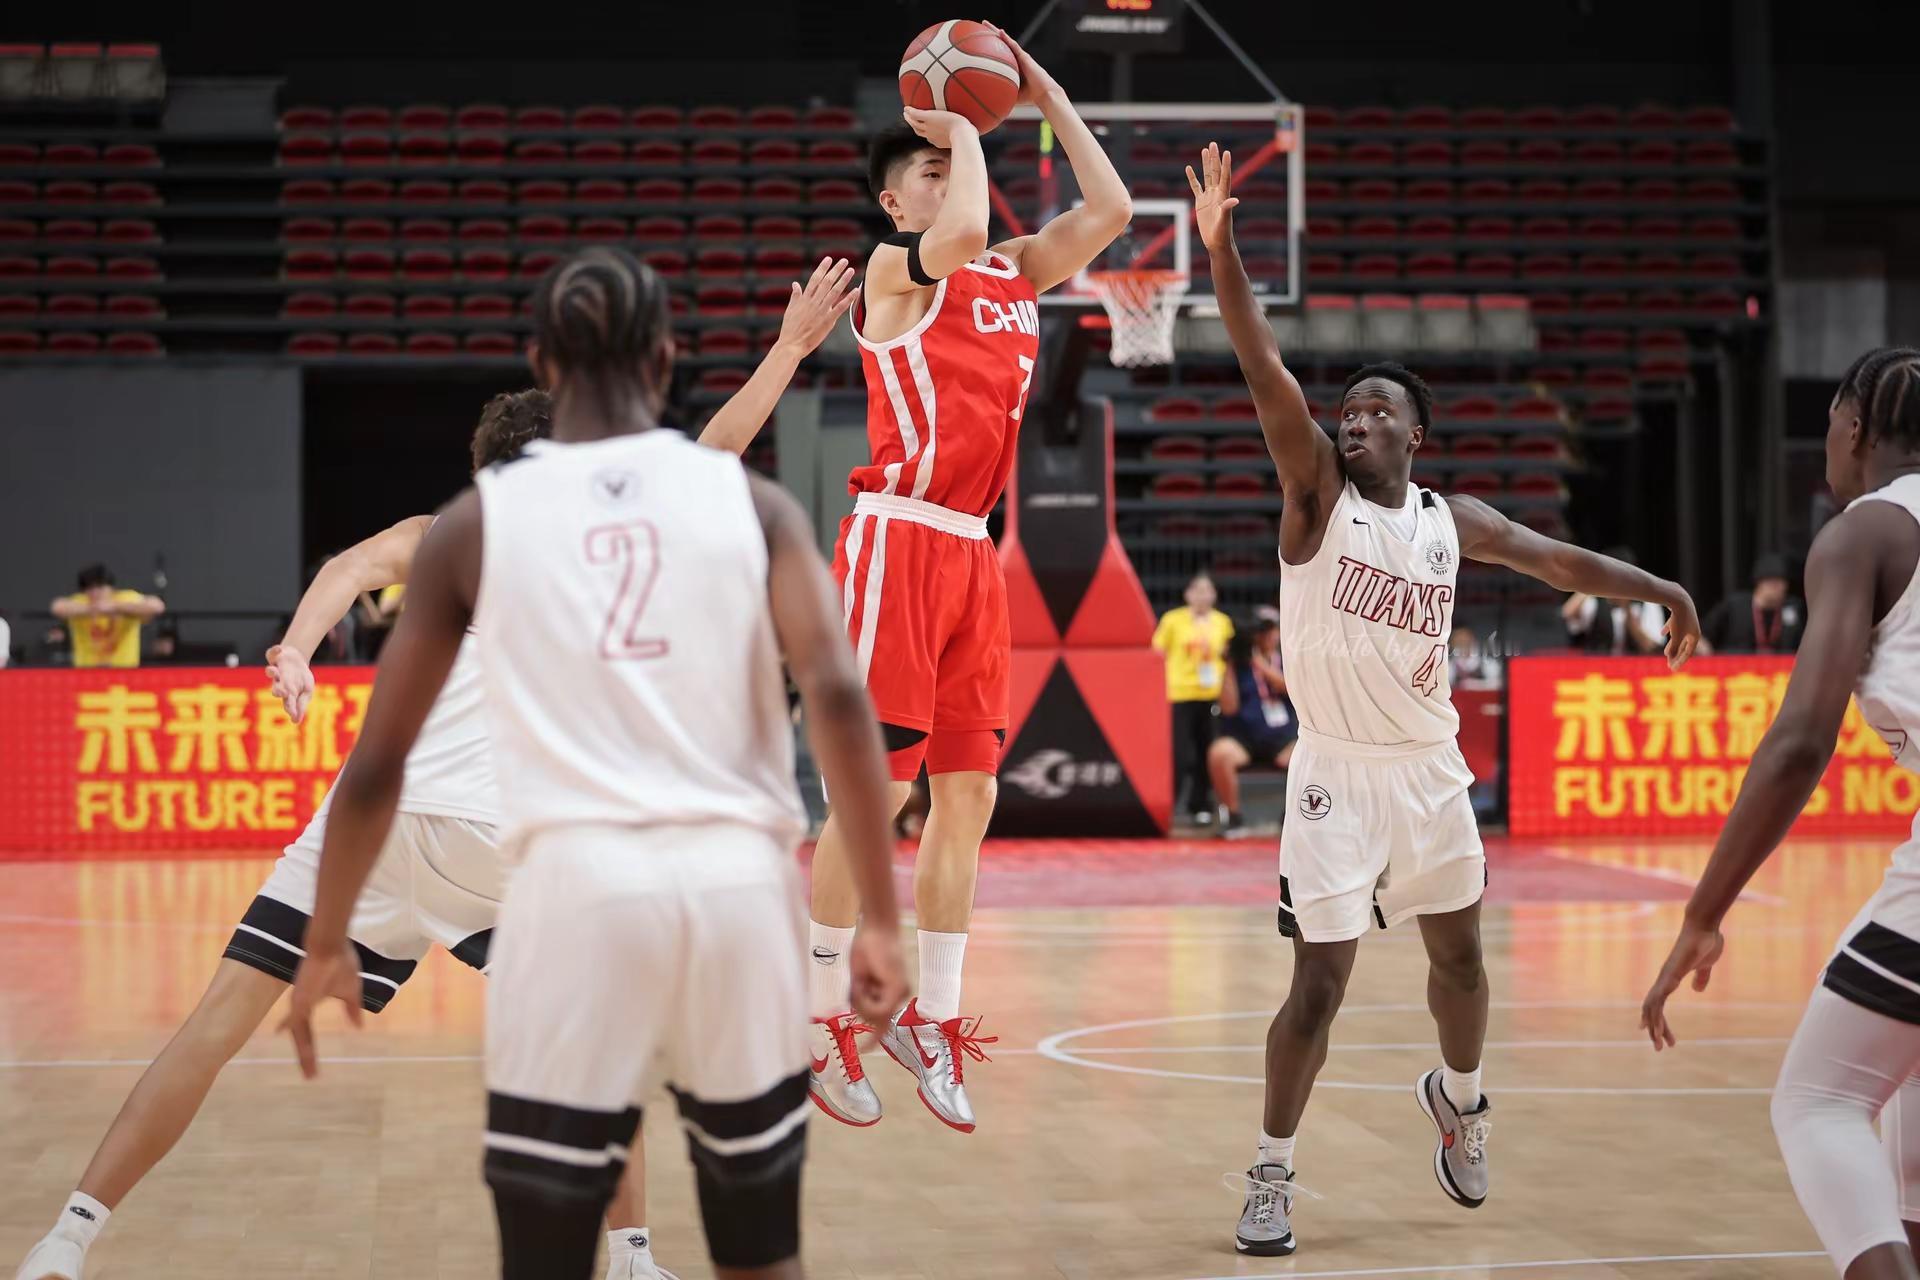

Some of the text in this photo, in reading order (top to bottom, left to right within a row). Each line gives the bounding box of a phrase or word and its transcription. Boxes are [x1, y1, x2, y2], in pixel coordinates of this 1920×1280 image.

[1008, 353, 1035, 421] 7
[584, 517, 670, 660] 2
[1331, 555, 1453, 637] TITANS
[1412, 644, 1446, 697] 4
[76, 684, 374, 773] 未来就
[76, 779, 297, 831] FUTURE
